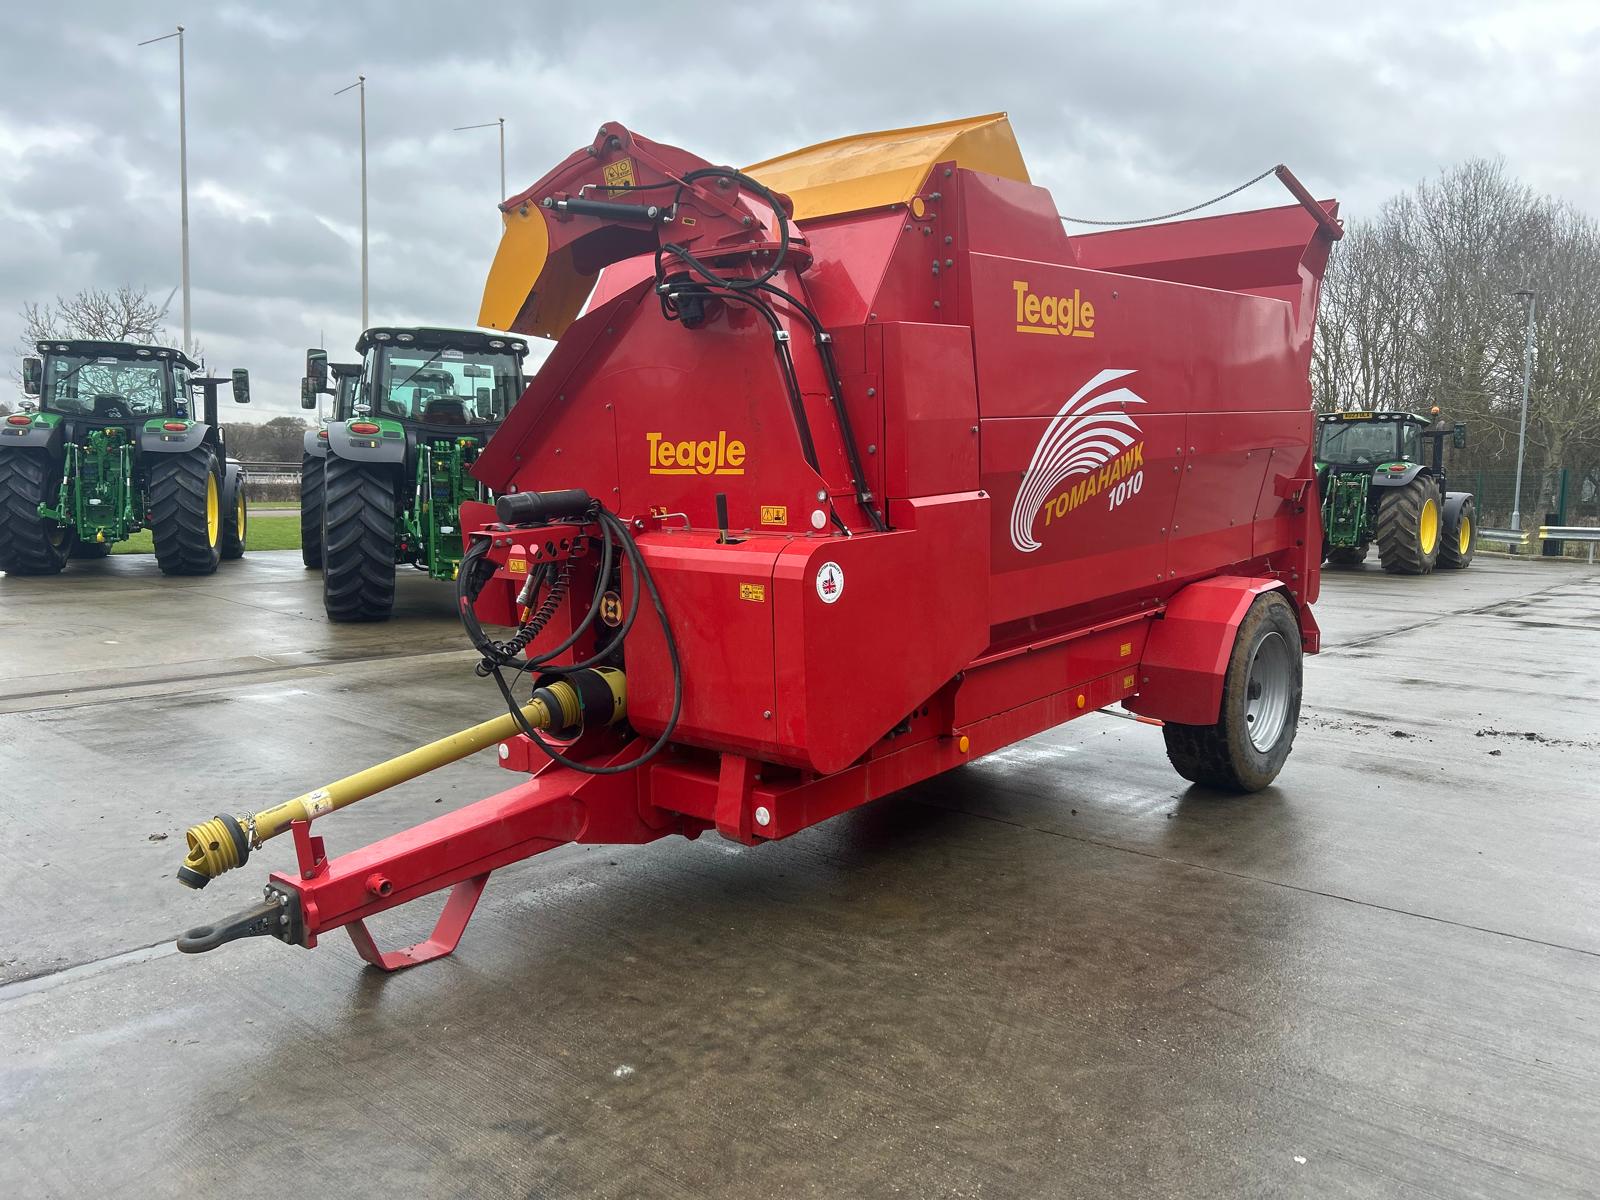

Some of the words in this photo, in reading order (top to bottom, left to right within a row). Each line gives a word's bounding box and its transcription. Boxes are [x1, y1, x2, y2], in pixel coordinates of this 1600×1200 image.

[1012, 280, 1095, 338] Teagle
[646, 430, 746, 475] Teagle
[1044, 440, 1144, 526] TOMAHAWK
[1108, 470, 1144, 512] 1010
